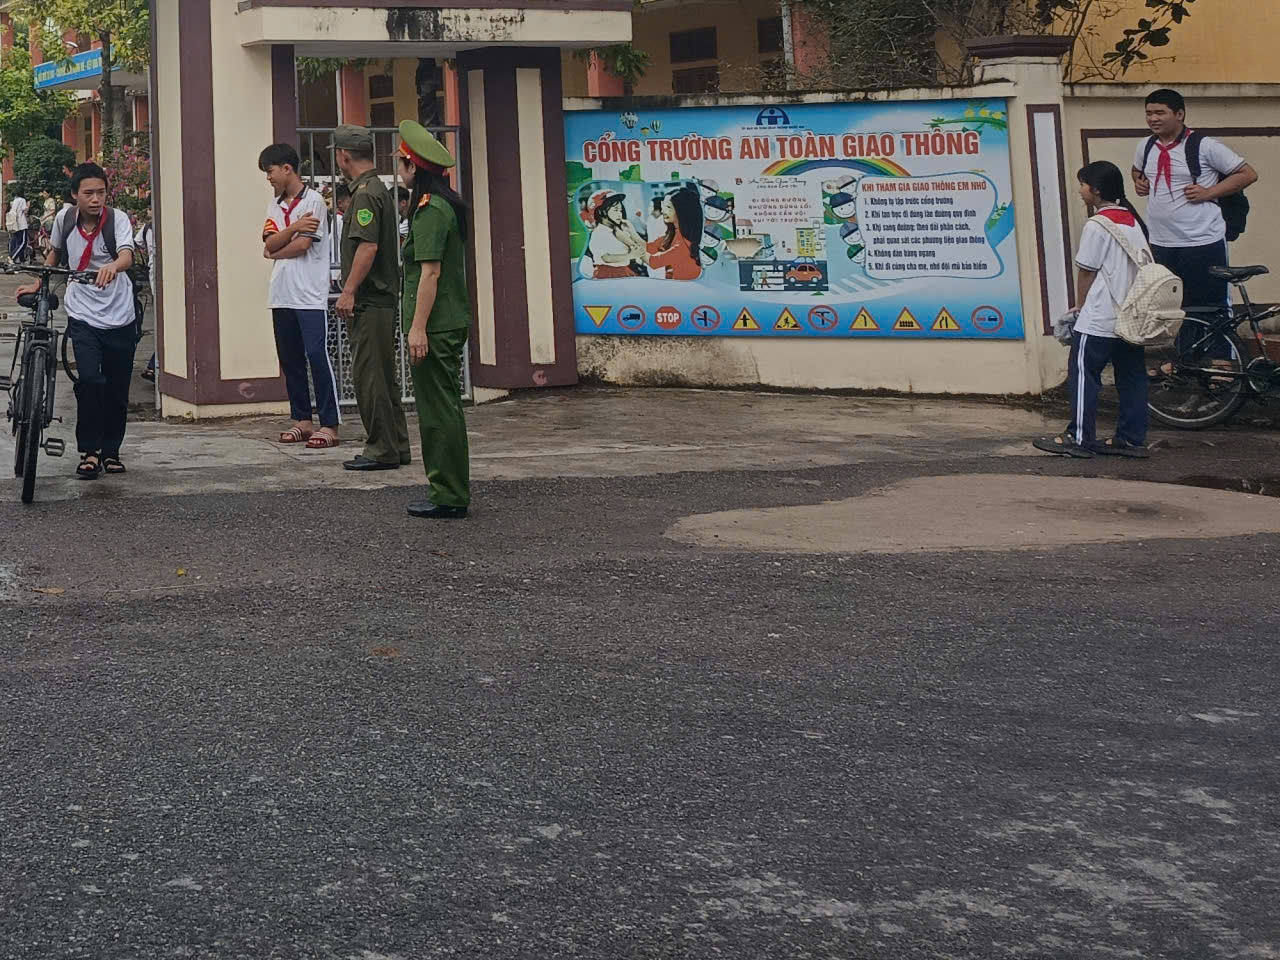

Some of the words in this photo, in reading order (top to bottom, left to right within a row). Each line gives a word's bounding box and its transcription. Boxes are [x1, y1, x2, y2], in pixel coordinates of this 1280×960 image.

[583, 131, 641, 163] CỔNG
[647, 133, 733, 162] TRƯỜNG
[739, 137, 770, 159] AN
[775, 131, 836, 159] TOÀN
[842, 134, 895, 157] GIAO
[902, 128, 980, 157] THÔNG
[861, 183, 874, 192] KHI
[875, 183, 897, 192] THAM
[899, 183, 911, 191] GIA
[912, 182, 930, 191] GIAO
[931, 180, 955, 191] THÔNG
[957, 182, 969, 190] EM
[971, 181, 987, 190] NHỚ
[656, 312, 680, 323] STOP
